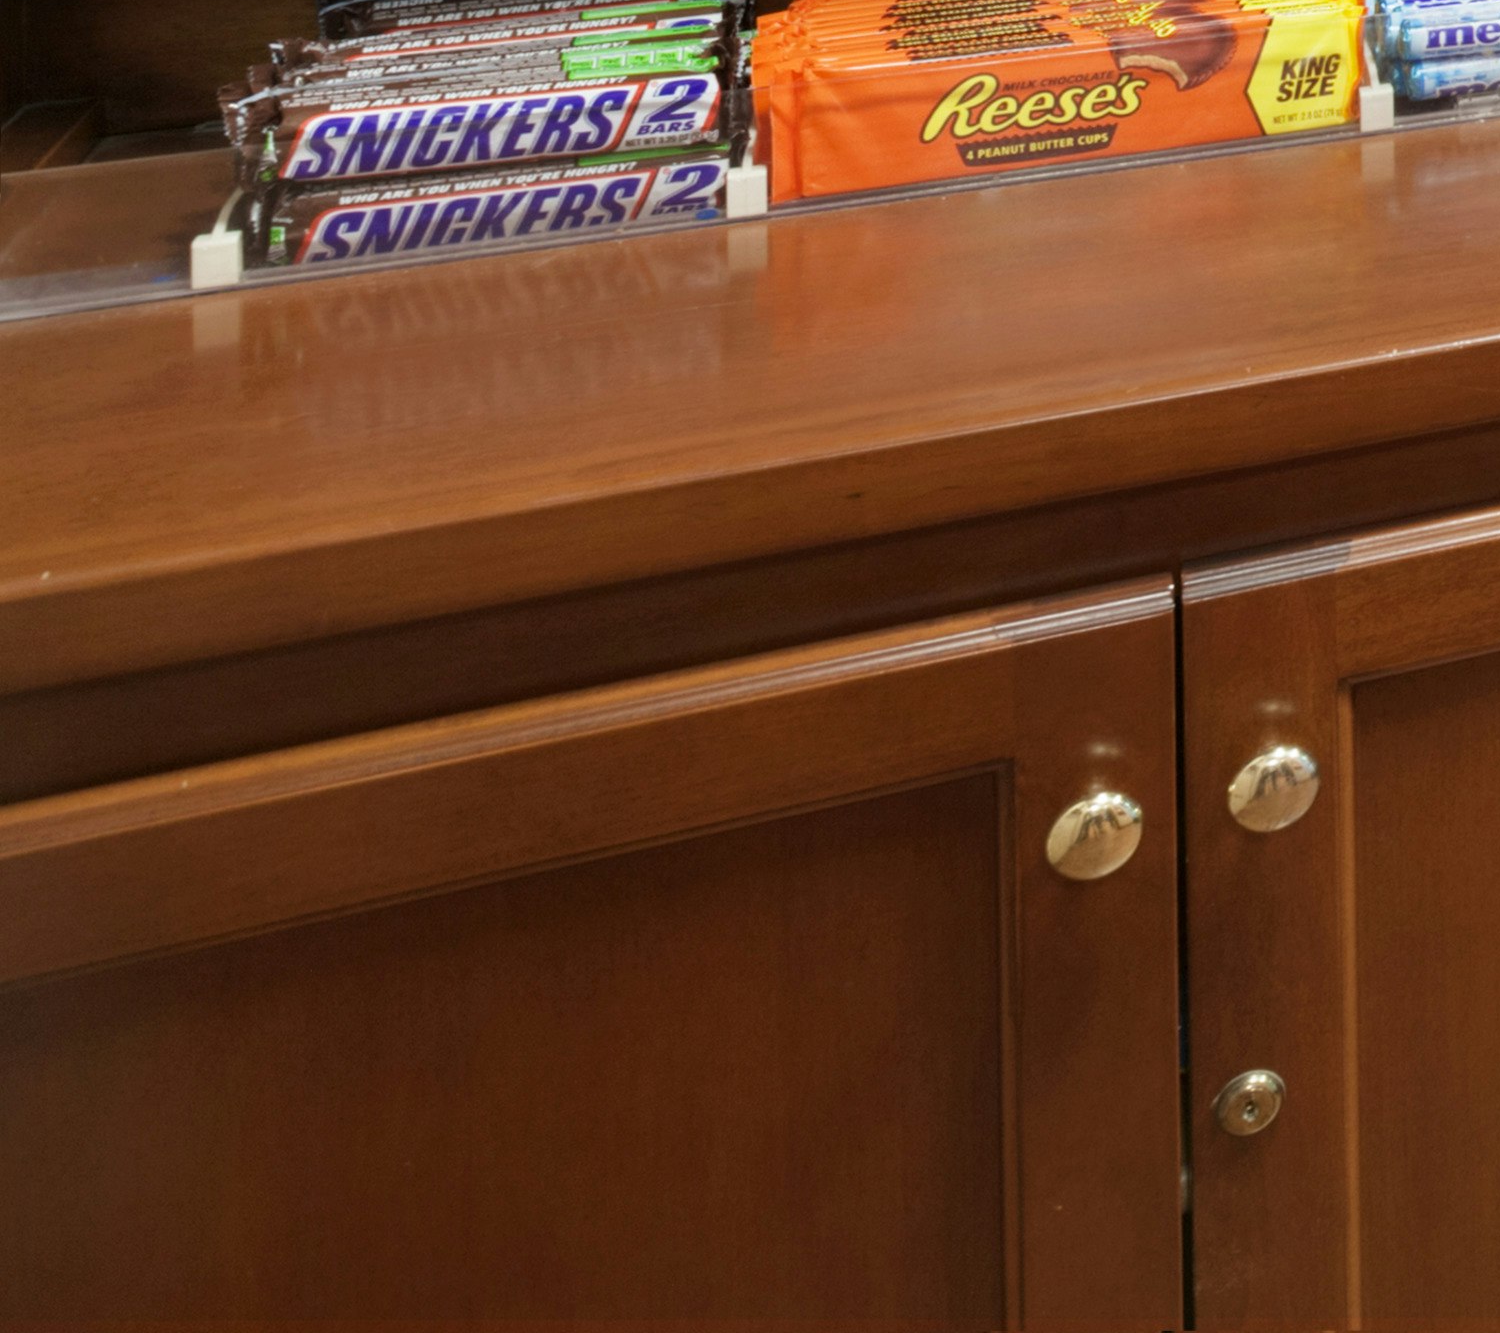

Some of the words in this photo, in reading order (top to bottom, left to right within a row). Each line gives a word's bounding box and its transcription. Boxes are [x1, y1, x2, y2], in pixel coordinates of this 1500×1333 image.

[1281, 54, 1342, 78] KING
[330, 99, 370, 111] WHO
[371, 96, 405, 108] ARE
[407, 93, 440, 106] YOU
[444, 88, 494, 102] WHEN
[553, 75, 627, 90] HUNGRY?
[643, 78, 708, 123] 2
[920, 73, 1150, 143] Reese's
[1276, 74, 1336, 102] SIZE
[293, 89, 630, 180] SNICKERS
[636, 120, 695, 136] BARS
[310, 175, 643, 264] SNICKERS
